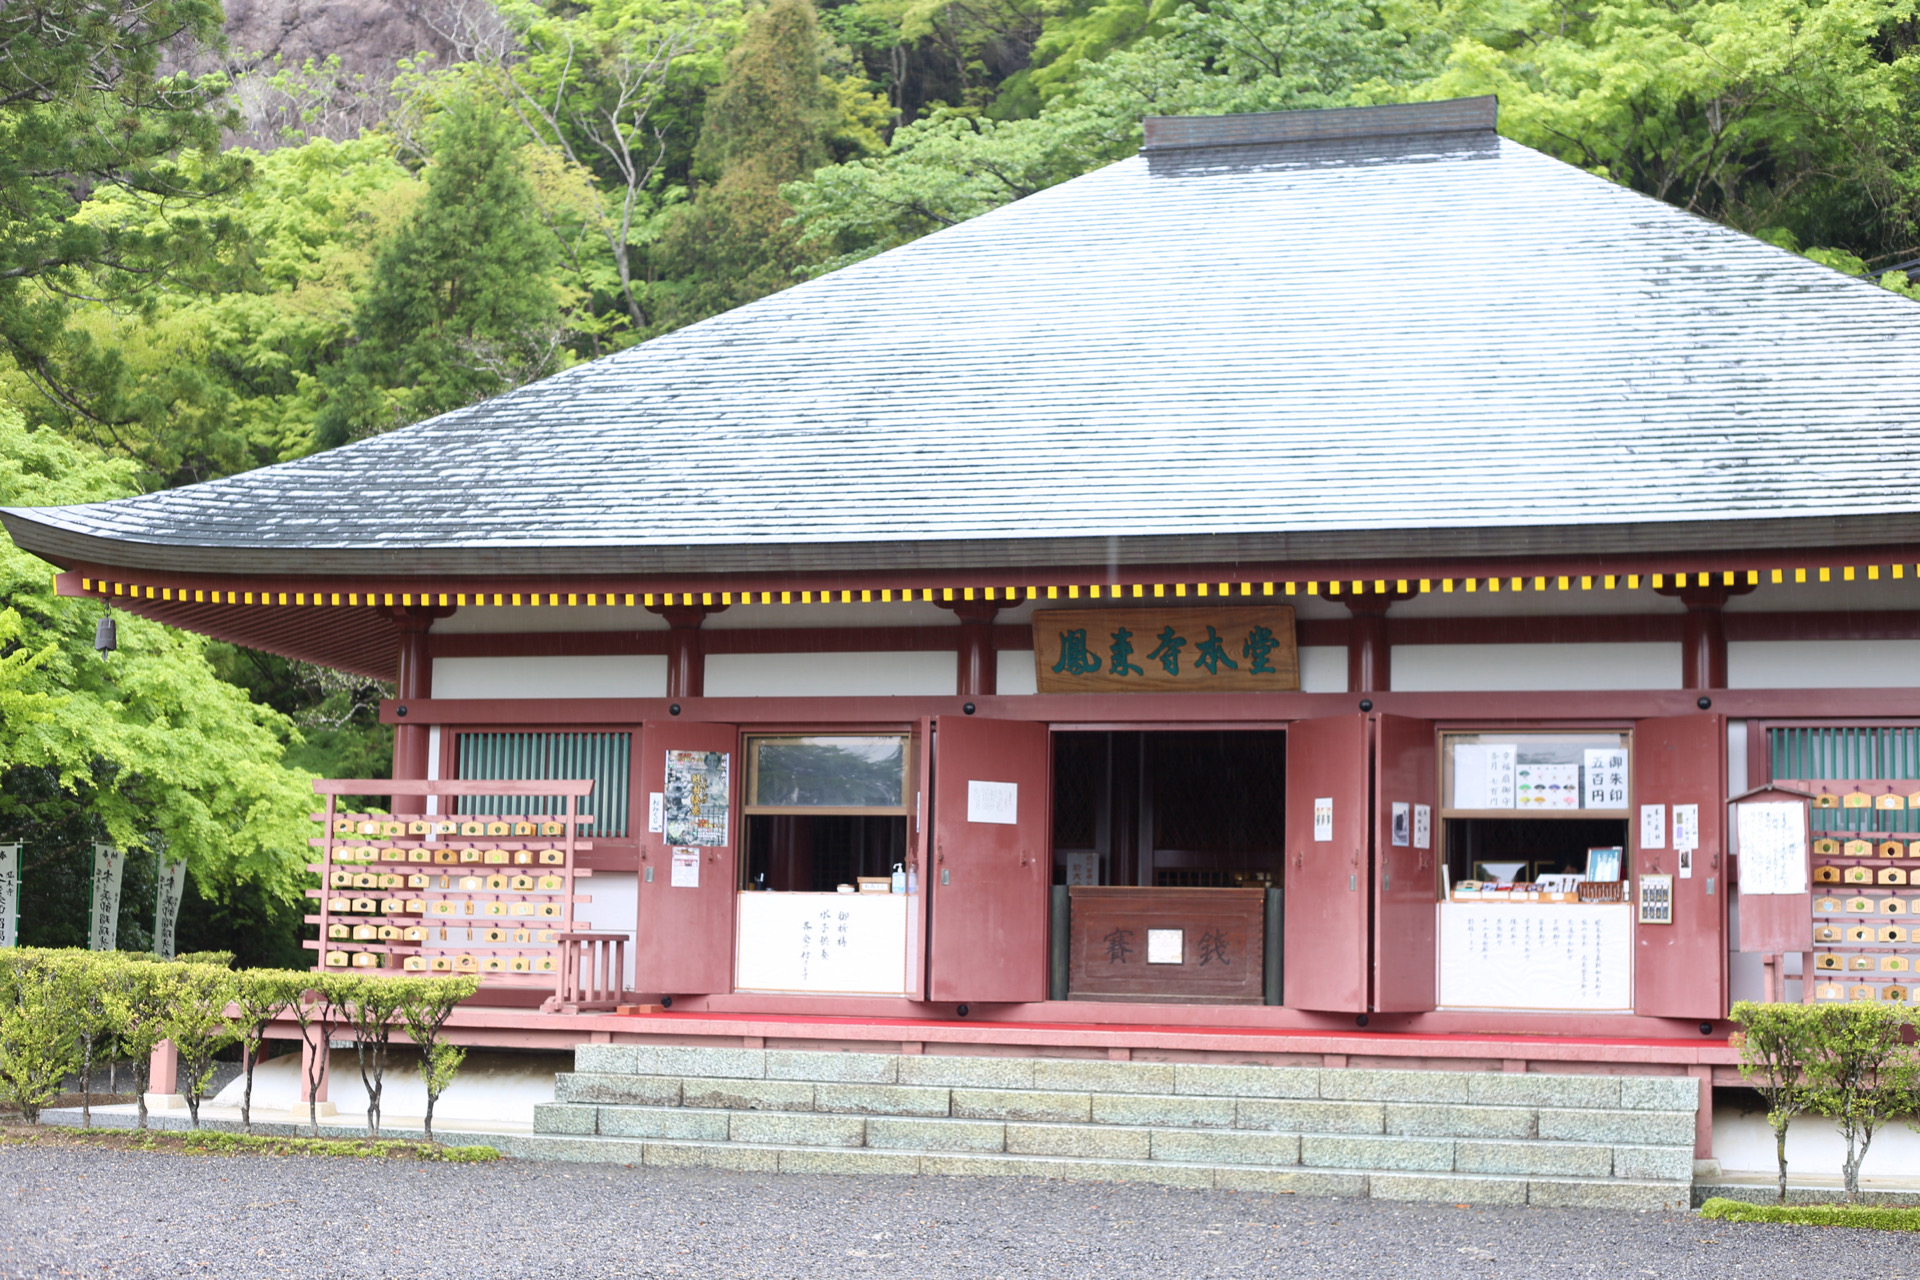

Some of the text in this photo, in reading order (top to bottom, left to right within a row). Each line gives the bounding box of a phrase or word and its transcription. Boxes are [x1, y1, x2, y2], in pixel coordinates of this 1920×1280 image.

[1591, 756, 1605, 803] 五百円
[1609, 756, 1623, 803] 御朱印
